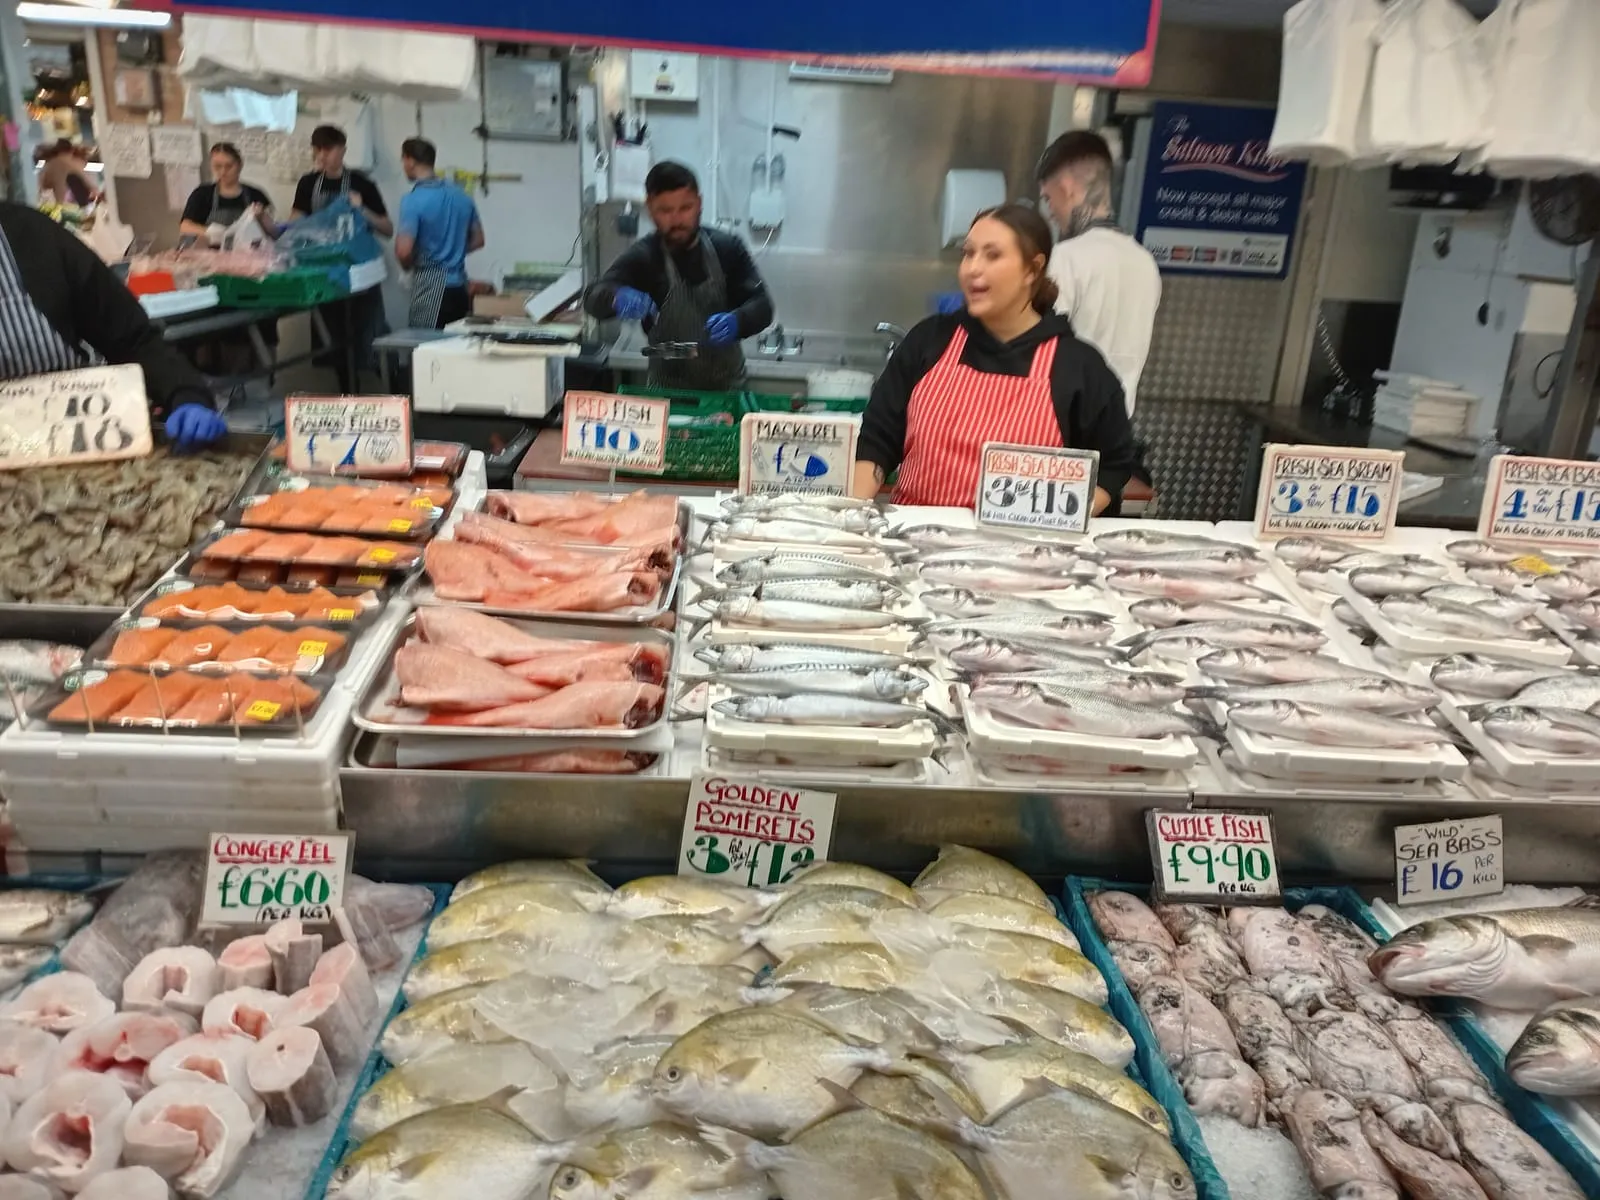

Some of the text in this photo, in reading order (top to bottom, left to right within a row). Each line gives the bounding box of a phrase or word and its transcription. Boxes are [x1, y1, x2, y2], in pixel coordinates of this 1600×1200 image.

[1157, 187, 1287, 211] Now accept all major
[1159, 206, 1195, 221] credit
[1209, 209, 1241, 223] debit
[1243, 211, 1279, 226] cards
[576, 396, 651, 422] RED FISH
[580, 420, 641, 453] £10
[757, 420, 839, 440] MACKEREL
[987, 451, 1085, 479] FRESH SEA BASS
[1276, 456, 1392, 481] FRESH SEA BREAM
[1505, 461, 1540, 480] FRESH
[1541, 462, 1570, 480] SEA
[985, 476, 1016, 507] 3
[1031, 479, 1079, 516] £15
[1271, 480, 1304, 513] 3
[1330, 482, 1380, 517] £15
[1503, 488, 1528, 518] 4
[695, 800, 815, 842] POMFRETS
[1159, 815, 1264, 840] CUTTLE FISH
[214, 834, 334, 862] CONGER EEL
[1397, 831, 1502, 861] SEA BASS
[686, 834, 815, 888] 3 £12
[1474, 853, 1495, 869] PER
[1218, 881, 1237, 894] PER
[1472, 873, 1497, 885] KILO
